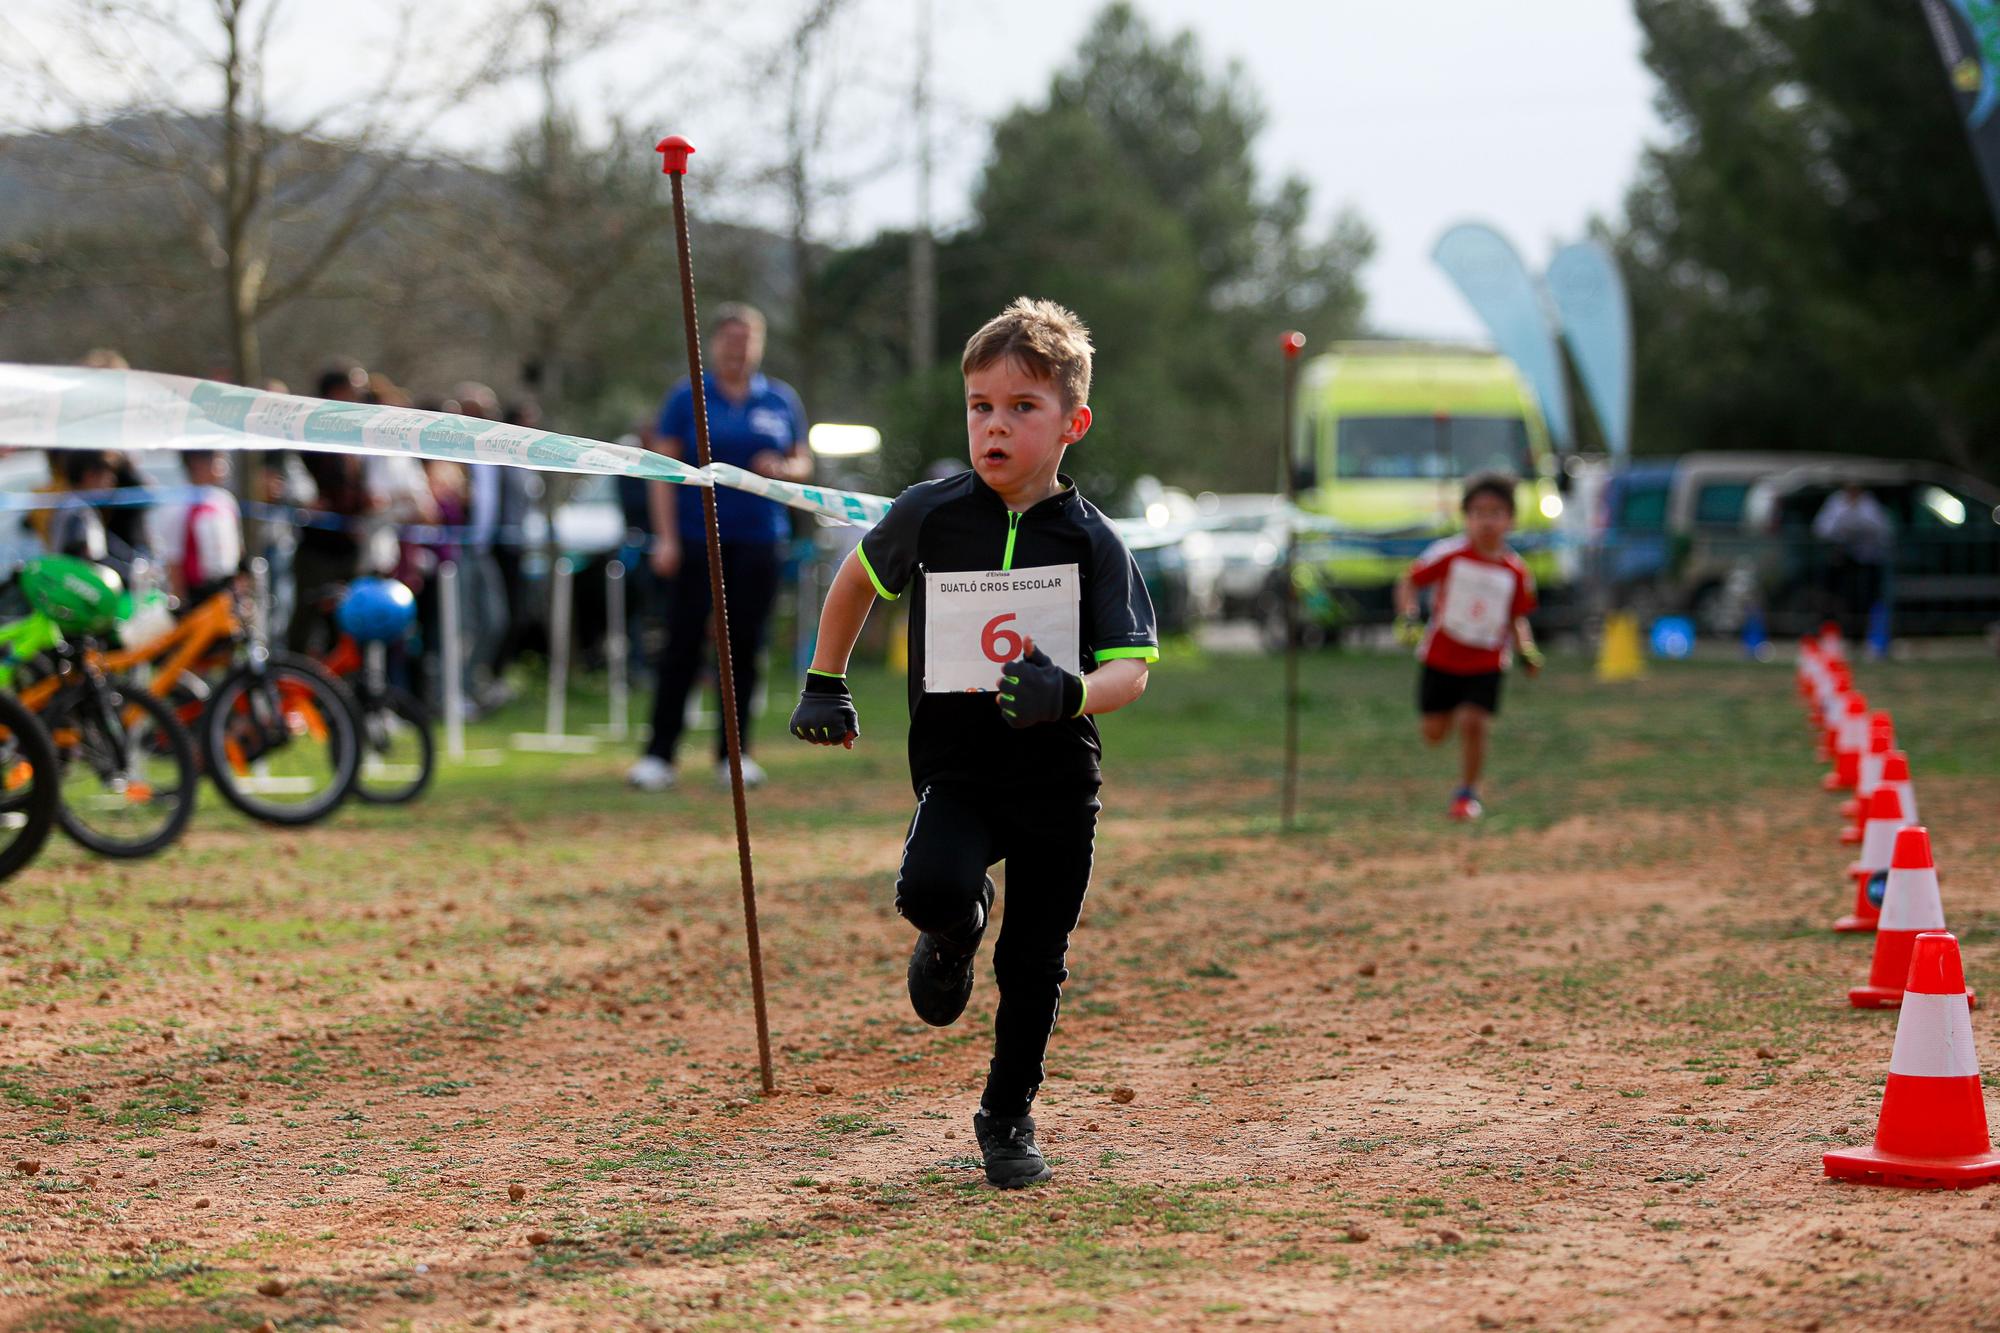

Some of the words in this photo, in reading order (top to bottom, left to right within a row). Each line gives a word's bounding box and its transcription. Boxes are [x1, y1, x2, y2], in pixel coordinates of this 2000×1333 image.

[940, 580, 977, 593] DUATLÓ
[980, 581, 1009, 592] CROS
[1013, 578, 1062, 591] ESCOLAR
[980, 612, 1023, 664] 6
